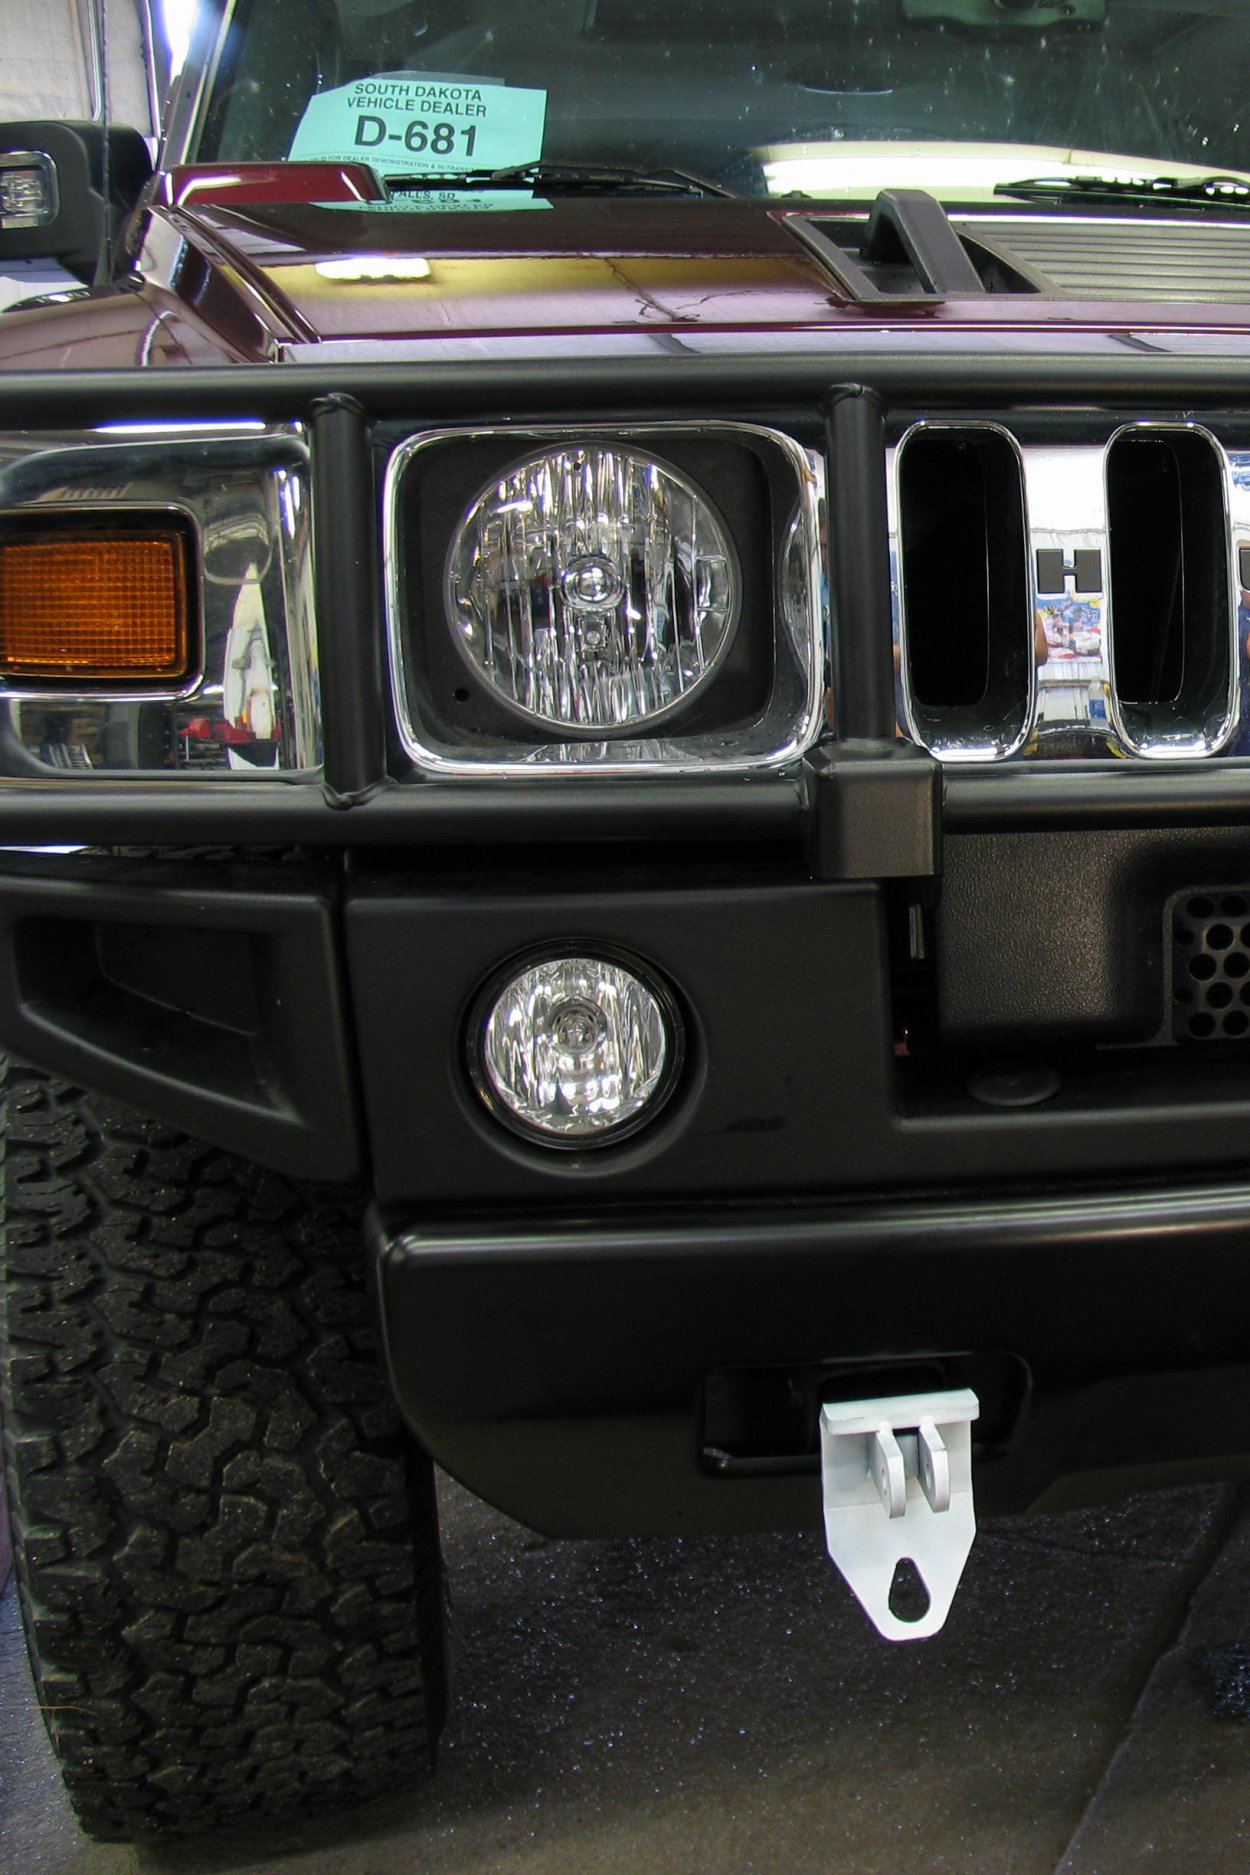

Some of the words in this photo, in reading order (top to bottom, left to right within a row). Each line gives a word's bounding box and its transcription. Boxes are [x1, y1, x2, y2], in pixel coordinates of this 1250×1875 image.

[354, 83, 410, 96] SOUTH
[415, 86, 482, 101] DAKOTA
[347, 97, 415, 111] VEHICLE
[420, 100, 487, 117] DEALER
[354, 115, 477, 156] D-681
[371, 157, 429, 169] DEMONSTRATION
